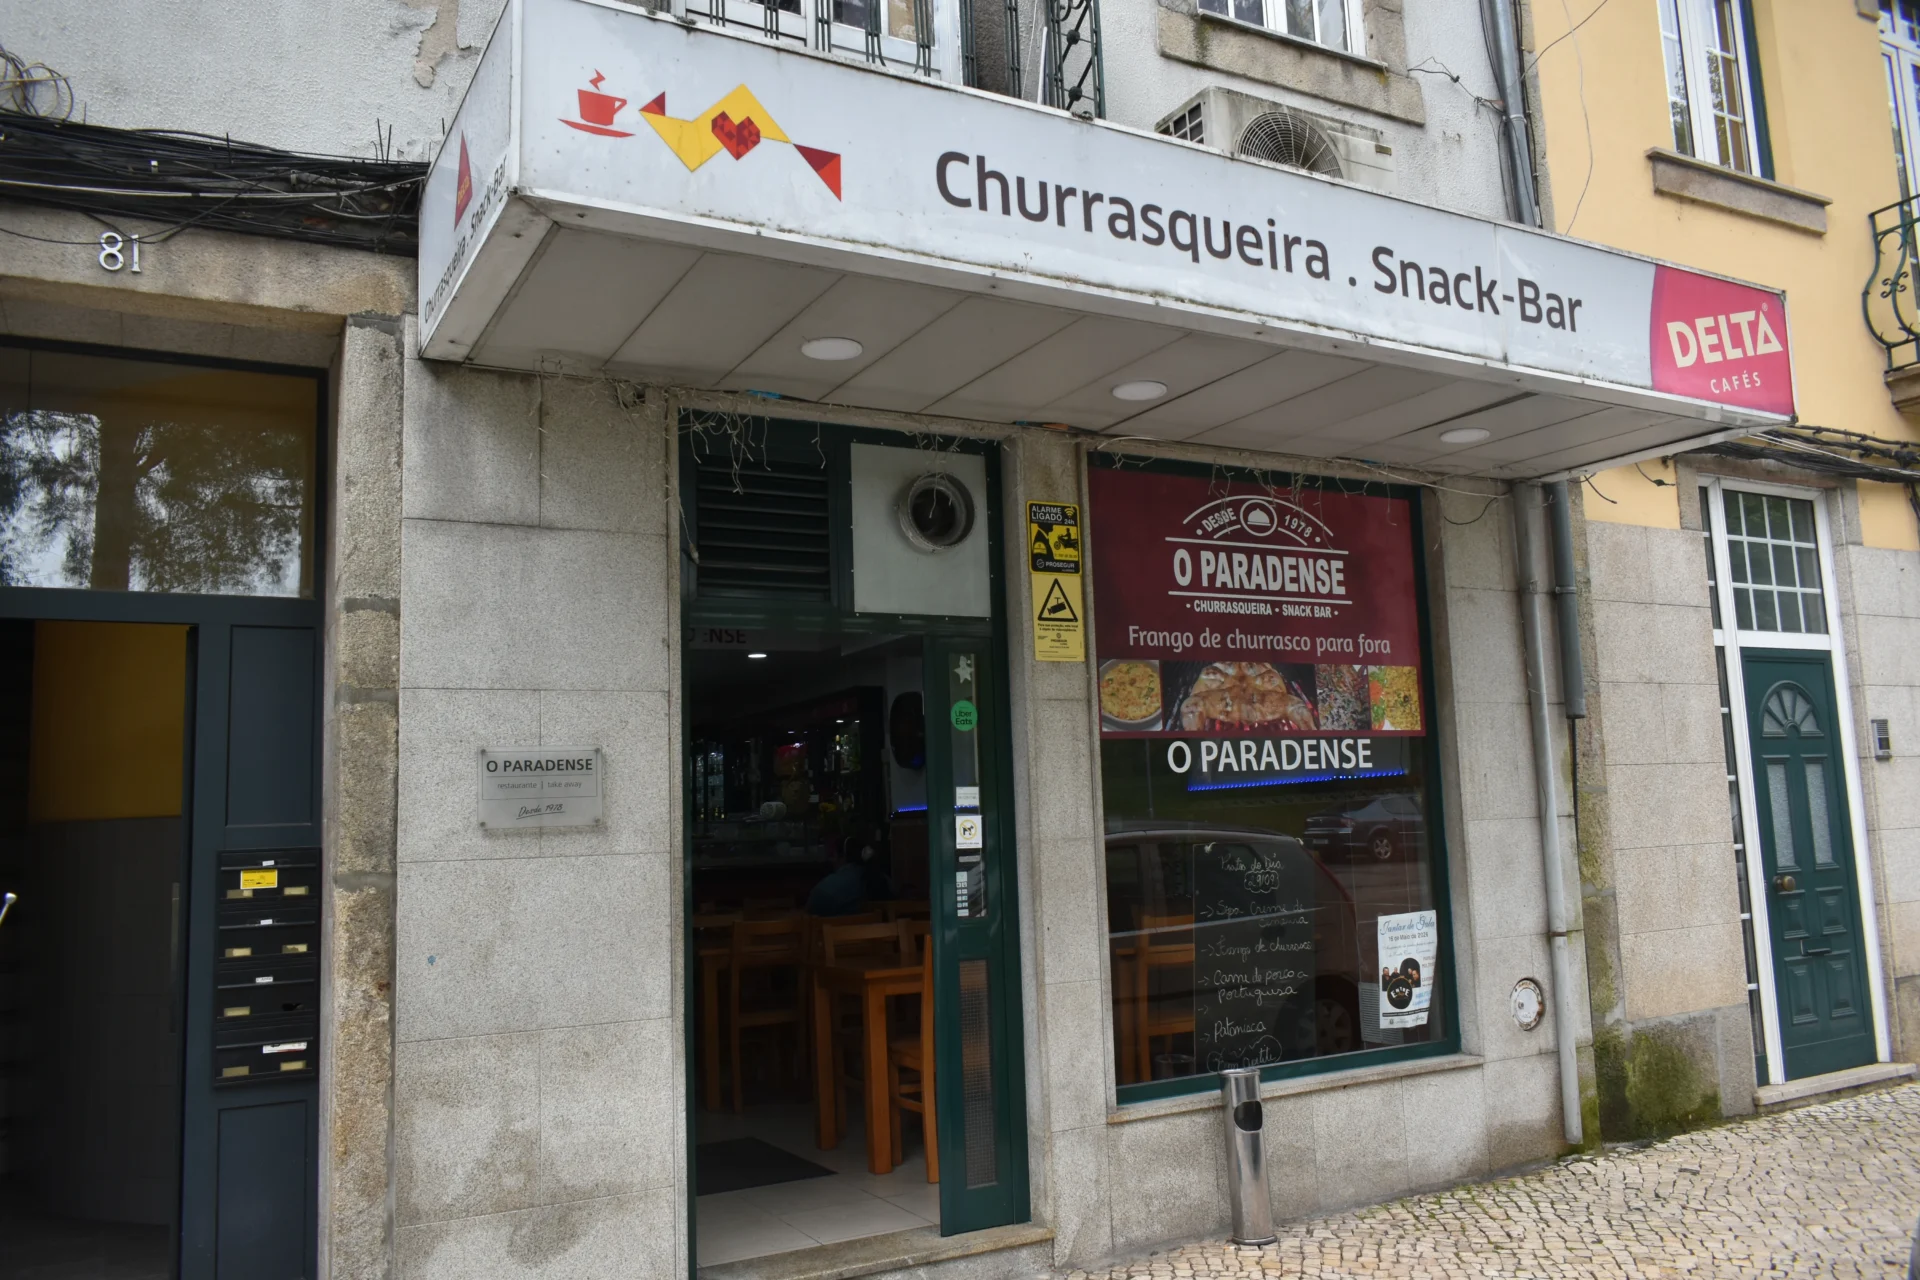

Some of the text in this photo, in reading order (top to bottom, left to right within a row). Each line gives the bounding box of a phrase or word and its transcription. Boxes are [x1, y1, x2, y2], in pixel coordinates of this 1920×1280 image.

[99, 231, 141, 272] 81
[936, 151, 1583, 333] Churrasqueira Snack-Bar
[1666, 310, 1783, 368] DELTA
[1710, 370, 1762, 394] CAFÉS
[1031, 505, 1062, 514] ALARME
[1031, 512, 1062, 522] LIGADO
[1201, 507, 1313, 538] DESDE 1978
[1045, 561, 1075, 569] PROSEGUR
[1173, 548, 1347, 595] O PARADENSE
[1193, 600, 1332, 619] CHURRASQUEIRA SNACK BAR
[1128, 625, 1391, 658] Frango de churrasco para fora
[955, 710, 972, 718] Uber
[955, 717, 973, 725] Eats
[486, 758, 593, 773] O PARADENSE
[1167, 738, 1373, 774] O PARADENSE
[497, 781, 538, 789] restaurante
[564, 781, 582, 789] away
[518, 803, 564, 818] Desde 1978
